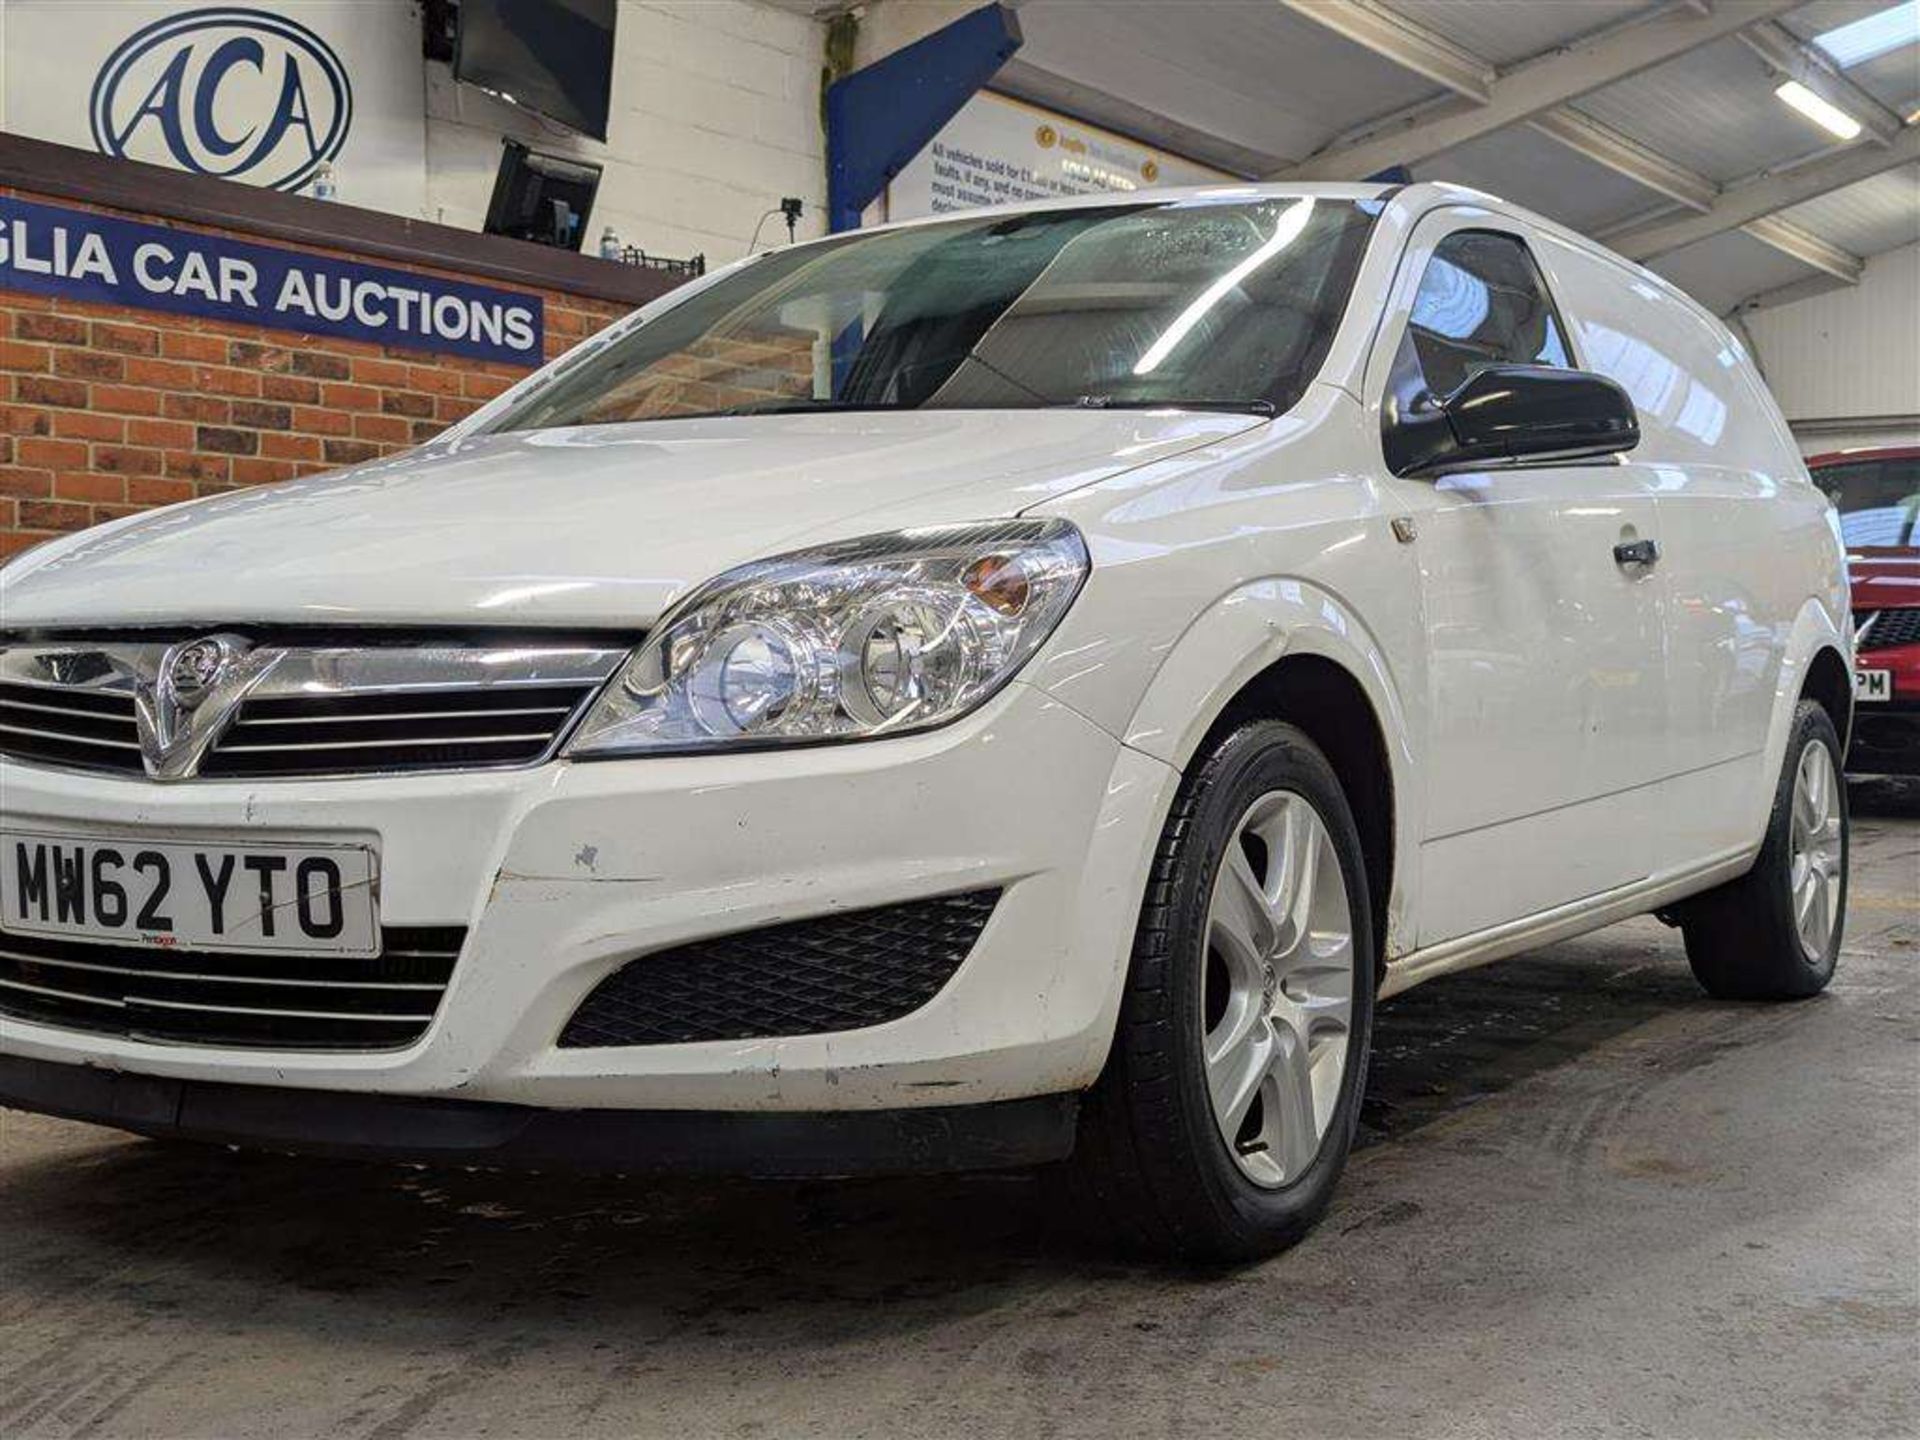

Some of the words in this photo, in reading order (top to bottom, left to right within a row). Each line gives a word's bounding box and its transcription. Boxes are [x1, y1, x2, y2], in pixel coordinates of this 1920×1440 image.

[115, 36, 318, 176] ACA
[932, 141, 944, 158] All
[946, 149, 983, 170] vehicles
[984, 160, 1005, 176] sold
[1006, 165, 1018, 179] for
[932, 182, 955, 198] must
[0, 217, 119, 285] LIA
[132, 242, 259, 308] CAR
[275, 268, 535, 350] AUCTIONS
[16, 841, 173, 932] MW62
[194, 853, 345, 940] YTO
